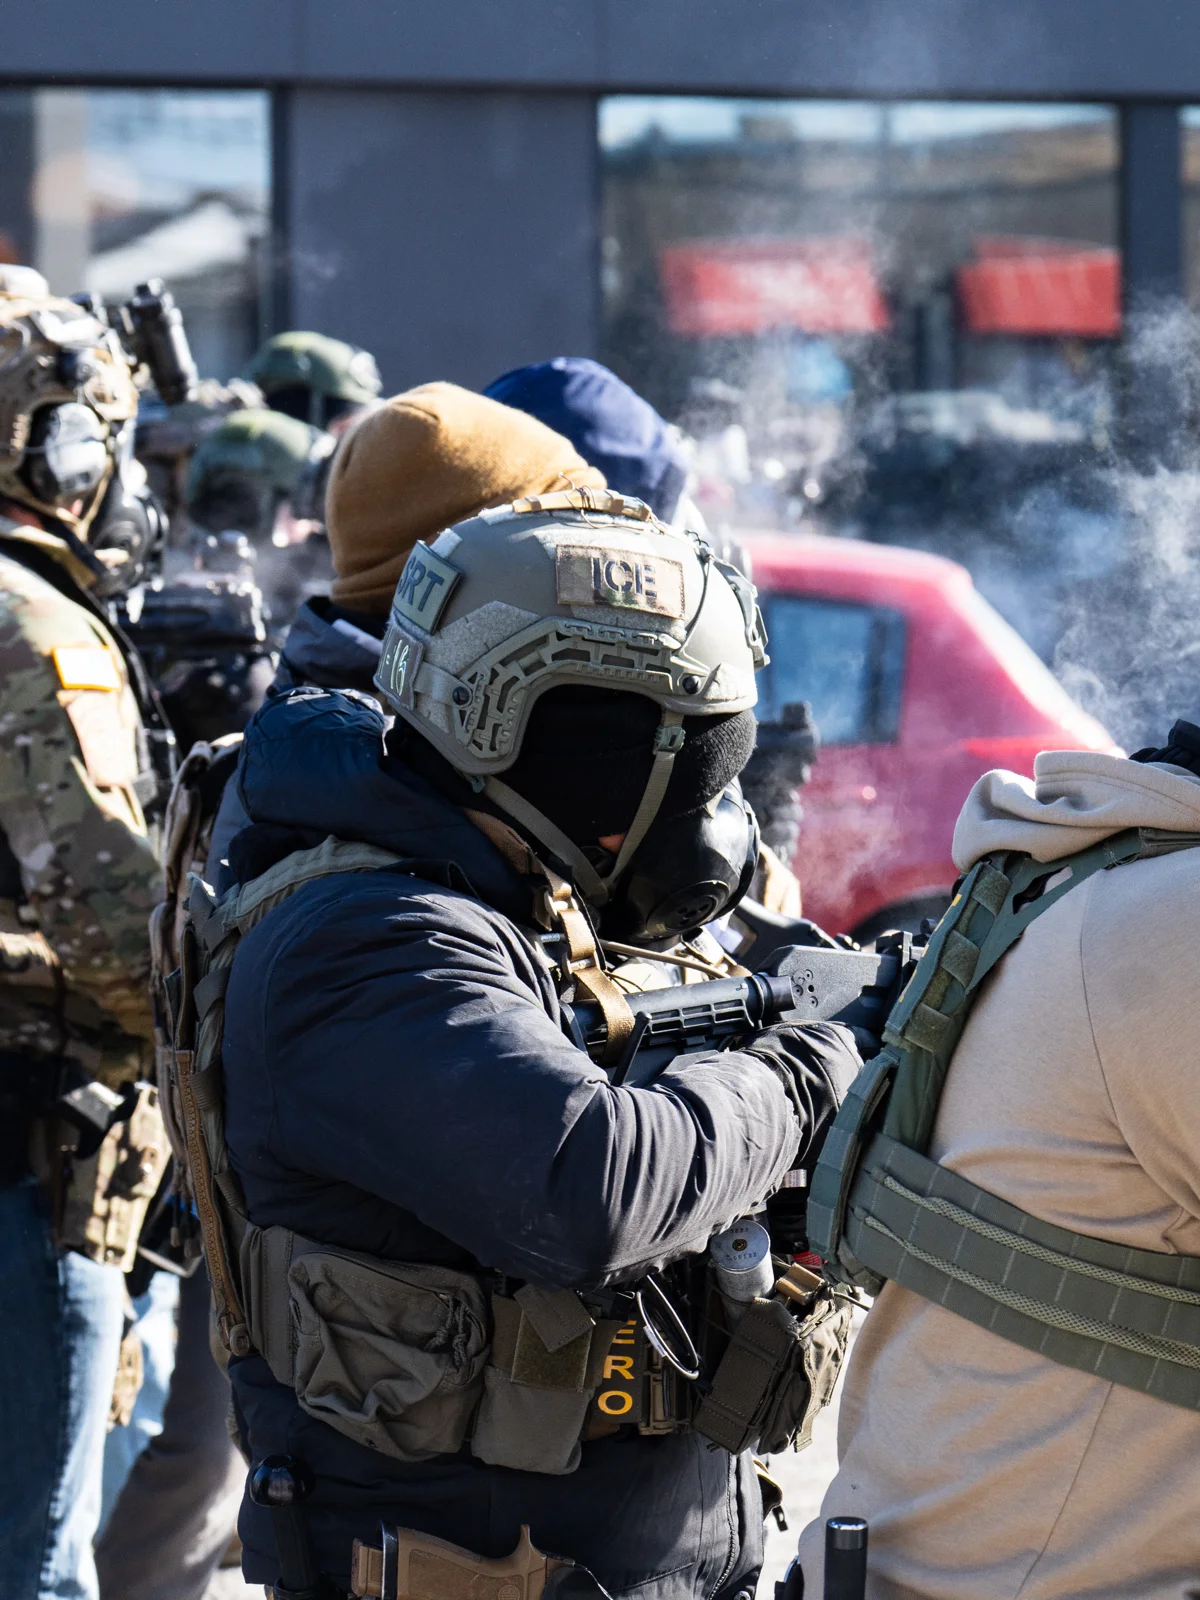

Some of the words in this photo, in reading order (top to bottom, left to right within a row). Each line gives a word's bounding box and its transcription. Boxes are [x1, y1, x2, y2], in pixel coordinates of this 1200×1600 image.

[397, 556, 445, 613] SRT
[592, 557, 657, 598] ICE
[597, 1320, 637, 1415] ERO
